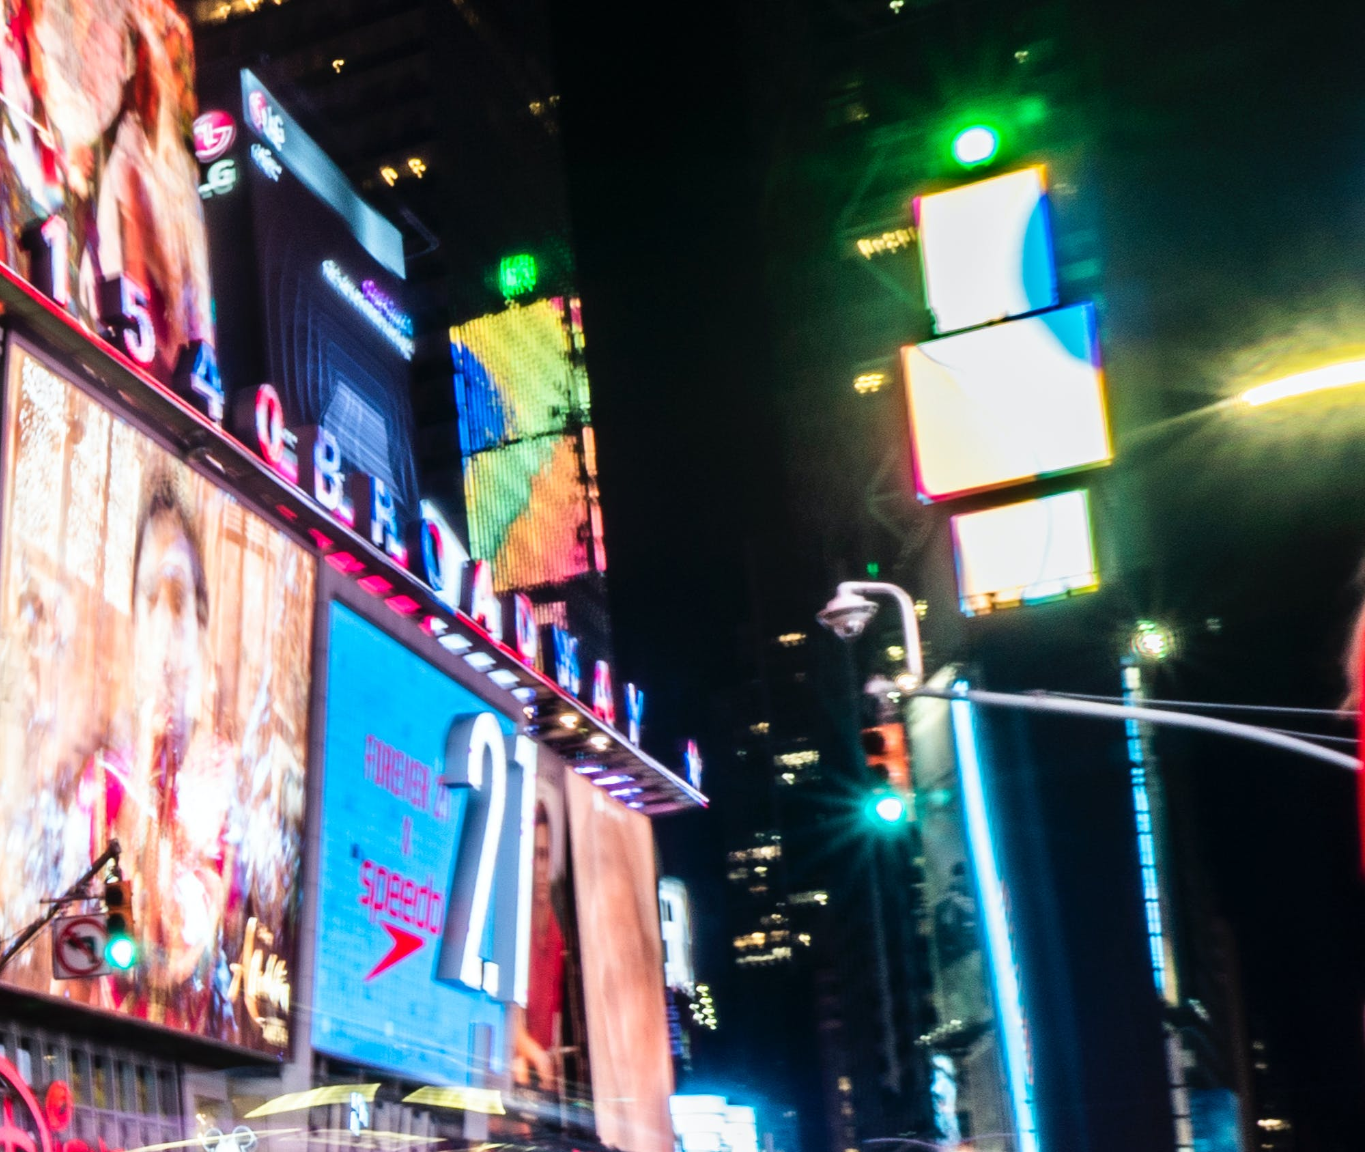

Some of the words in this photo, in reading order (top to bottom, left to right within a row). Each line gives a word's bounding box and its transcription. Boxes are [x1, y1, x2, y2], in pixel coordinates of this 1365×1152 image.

[42, 214, 286, 465] 1540
[313, 426, 645, 750] BROADWAY
[365, 735, 430, 812] FOREVER
[460, 712, 537, 1009] 21
[360, 859, 443, 937] speedo
